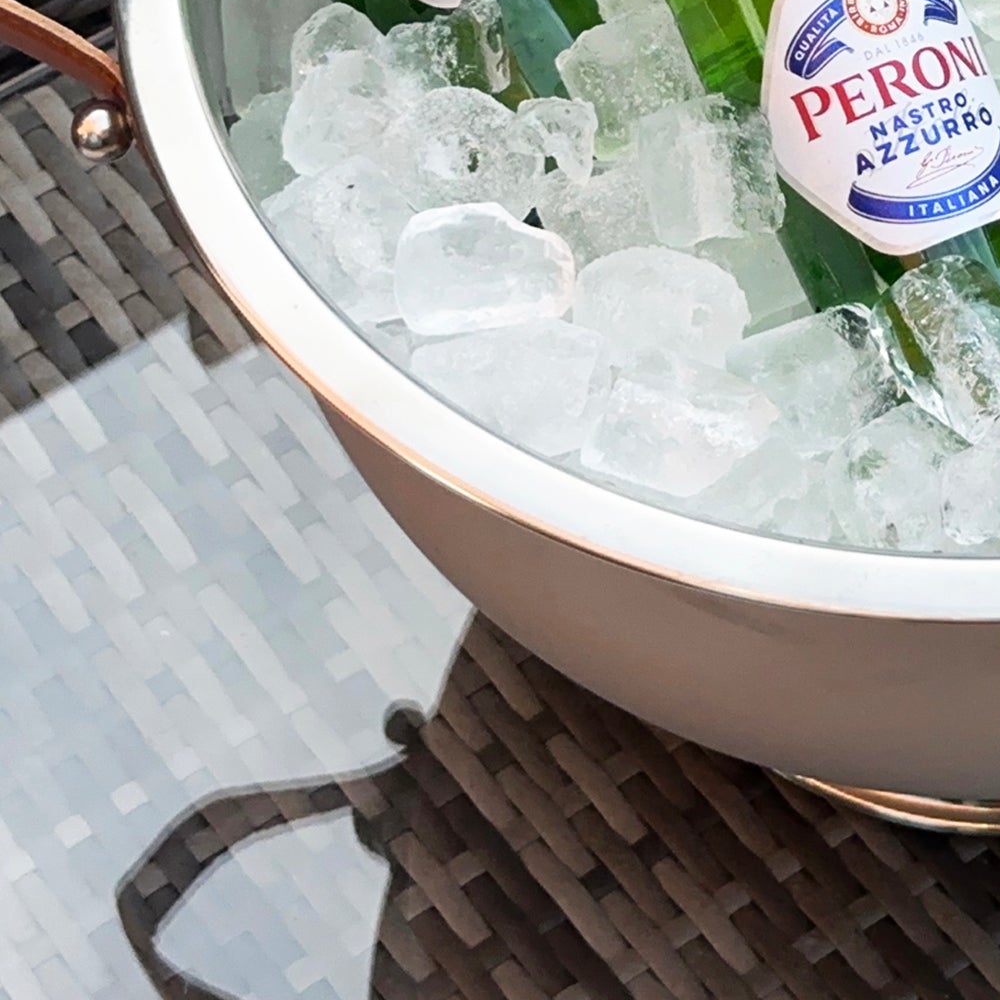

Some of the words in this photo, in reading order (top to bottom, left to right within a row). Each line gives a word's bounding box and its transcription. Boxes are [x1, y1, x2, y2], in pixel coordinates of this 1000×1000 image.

[794, 8, 839, 61] QUALITÀ
[870, 16, 906, 35] ROMA
[864, 45, 891, 61] DAL
[790, 36, 988, 143] PERONI
[856, 106, 993, 176] AZZURRO
[869, 92, 967, 141] NASTRO
[909, 174, 1000, 217] ITALIANA
